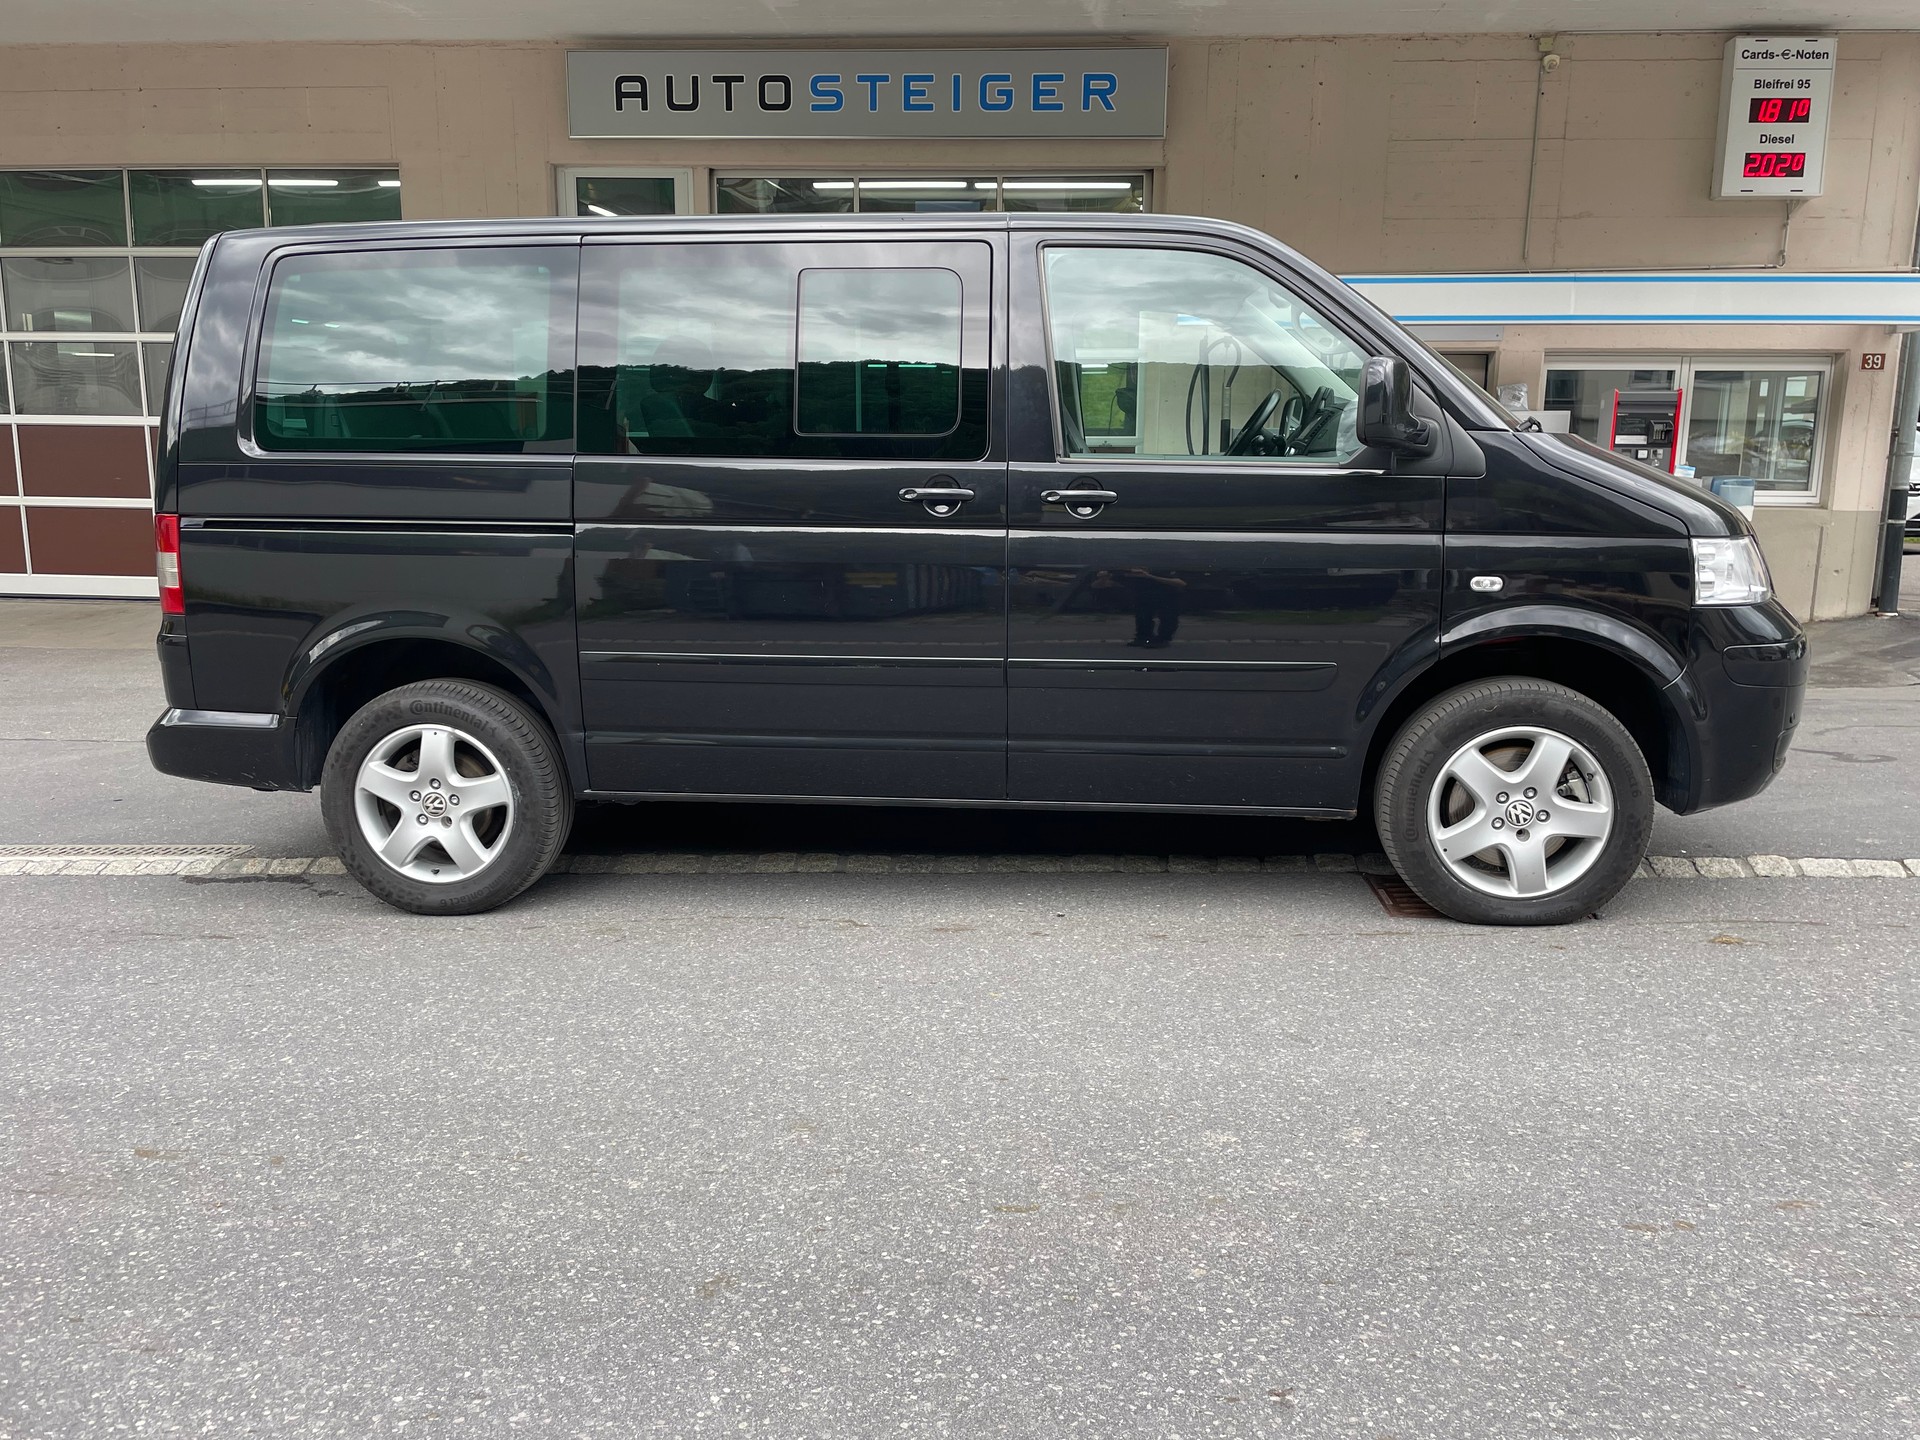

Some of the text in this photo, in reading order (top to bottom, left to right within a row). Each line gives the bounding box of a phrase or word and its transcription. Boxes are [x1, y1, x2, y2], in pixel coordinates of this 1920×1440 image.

[1741, 49, 1829, 60] Cards-€-Noten
[1753, 79, 1811, 89] Bleifrei 95
[1759, 134, 1795, 144] Diesel
[1864, 354, 1882, 369] 39
[409, 699, 490, 732] Continental
